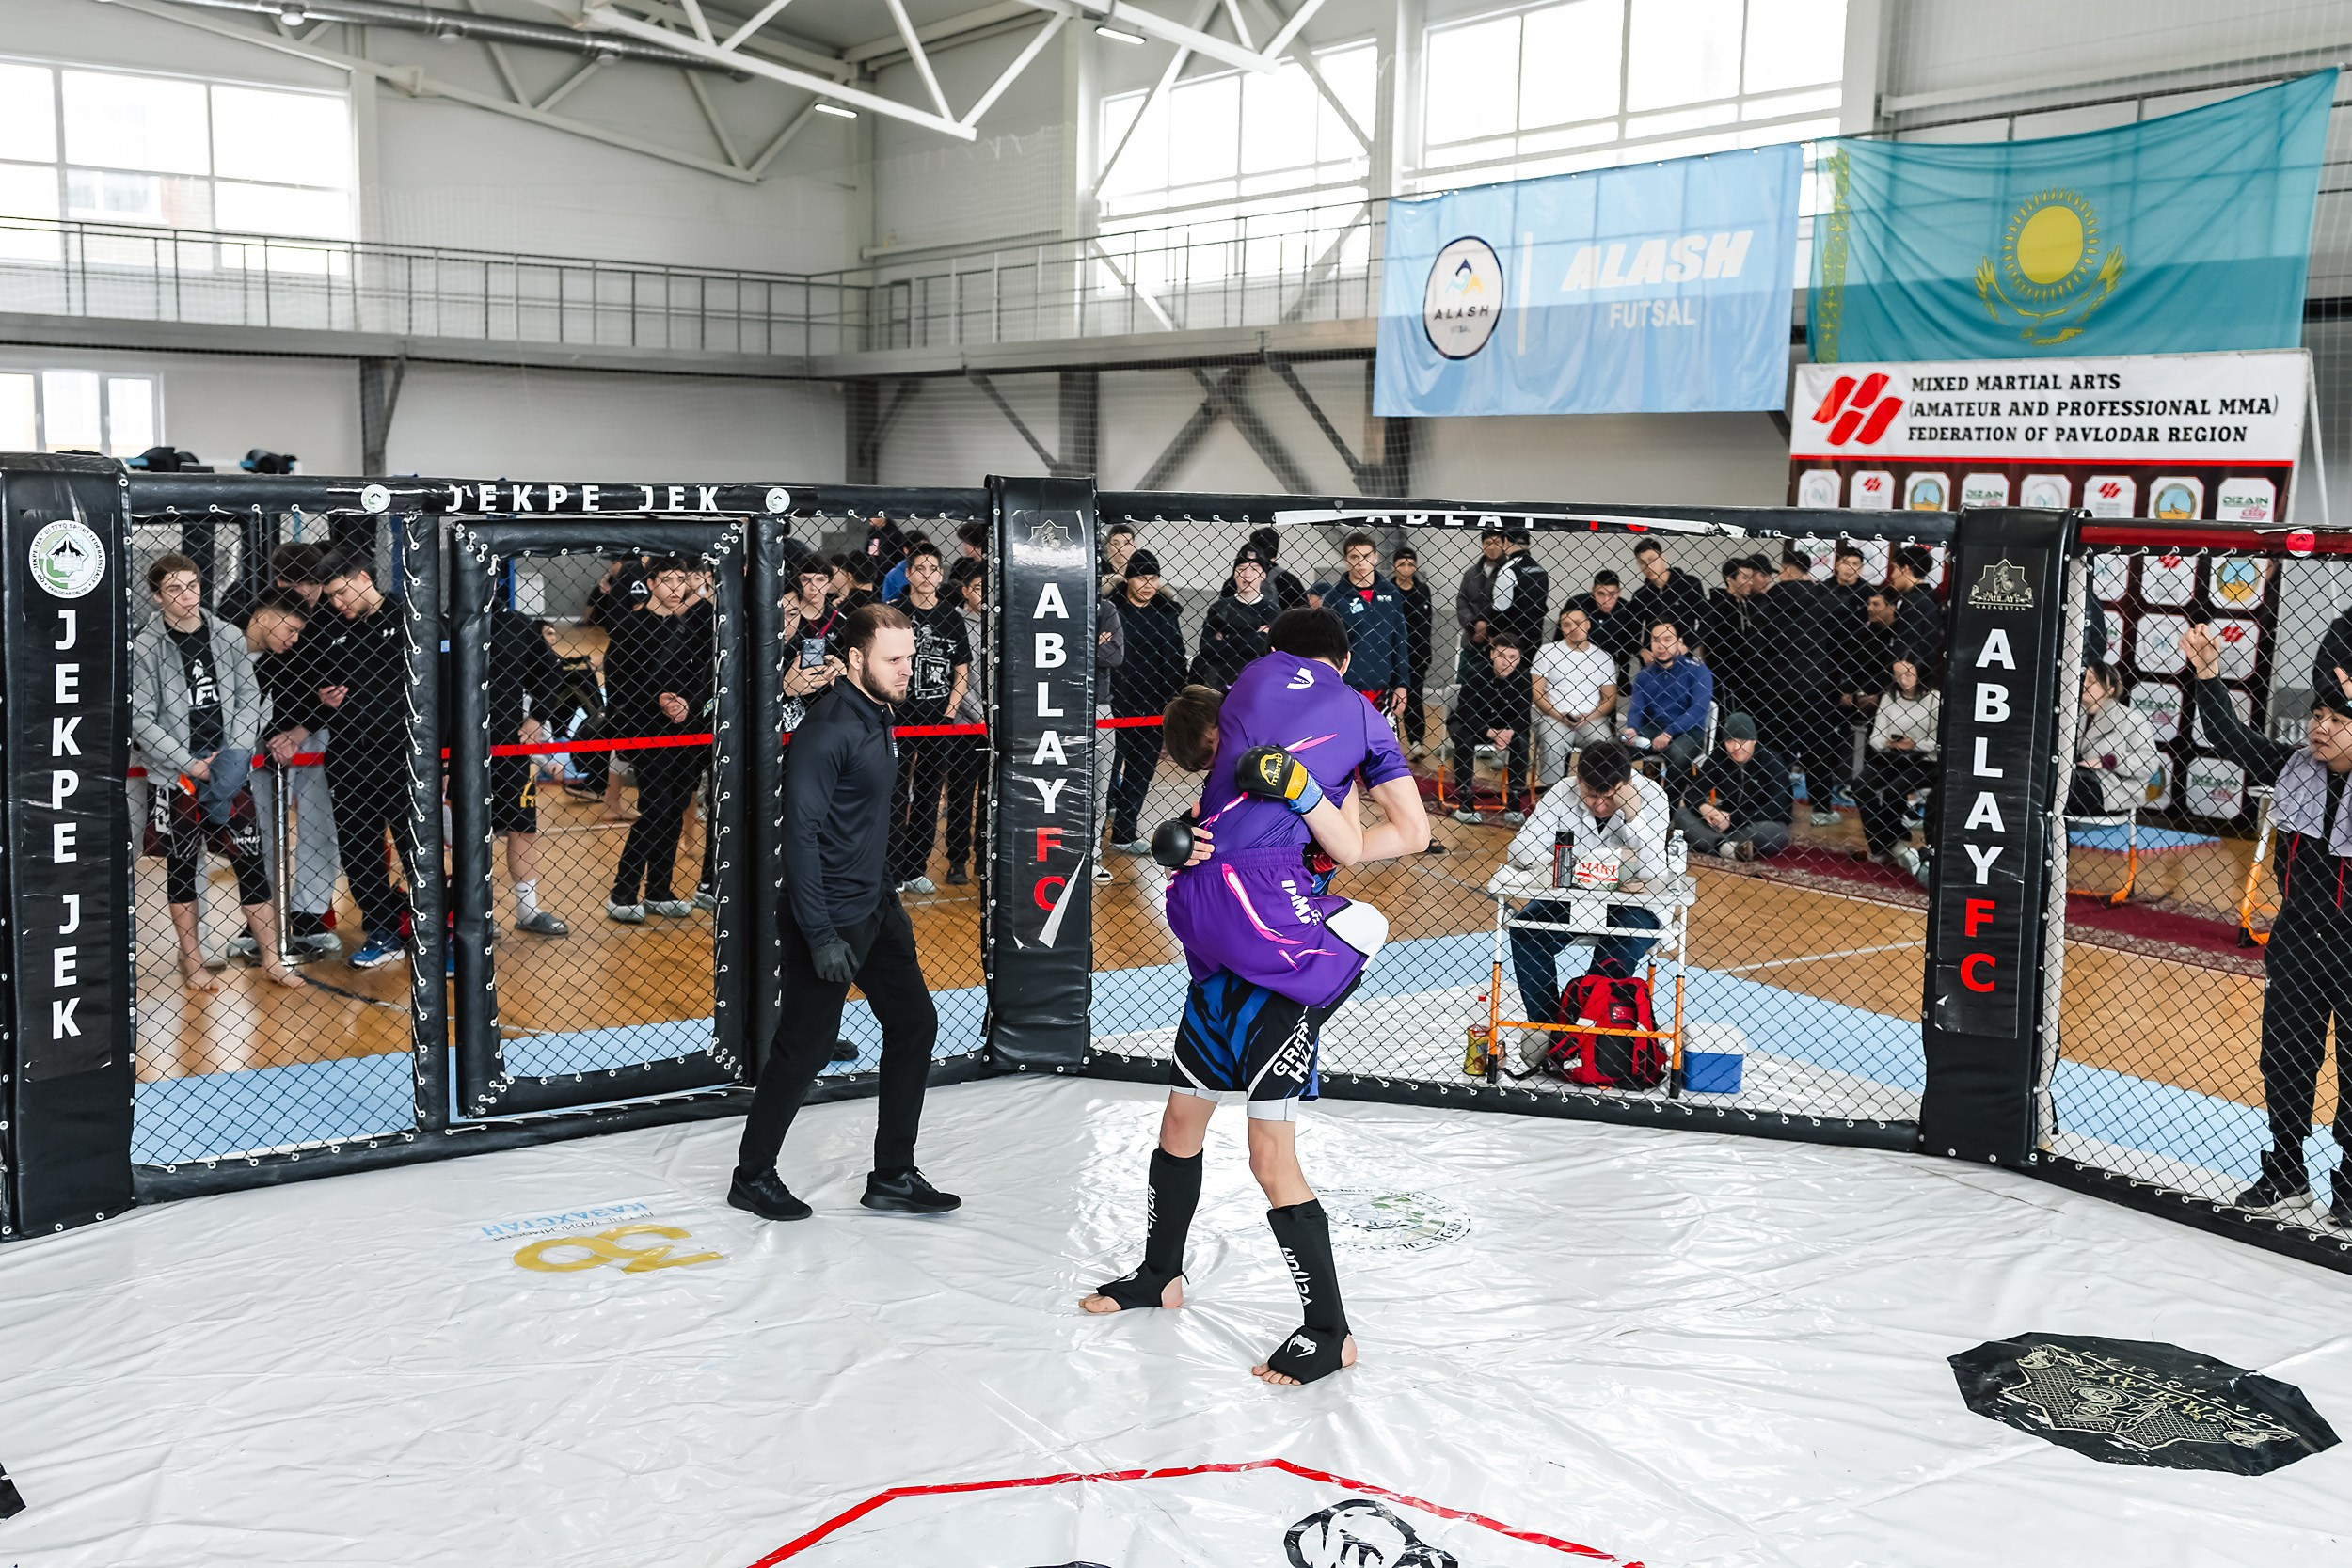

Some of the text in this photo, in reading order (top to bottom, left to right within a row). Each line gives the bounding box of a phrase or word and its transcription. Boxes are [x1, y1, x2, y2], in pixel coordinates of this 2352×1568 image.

[1561, 230, 1753, 292] ALASH
[1434, 305, 1489, 320] ALASH
[1610, 299, 1695, 329] FUTSAL
[1912, 373, 2121, 391] MIXED MARTIAL ARTS
[1909, 395, 2279, 418] (AMATEUR AND PROFESSIONAL MMA)
[1908, 426, 2248, 442] FEDERATION OF PAVLODAR REGION
[445, 484, 720, 513] JEKPE JEK
[52, 610, 82, 863] JEKPE
[1033, 582, 1069, 911] ABLAY FC
[1960, 628, 2016, 993] ABLAY FC
[52, 894, 82, 1040] JEK
